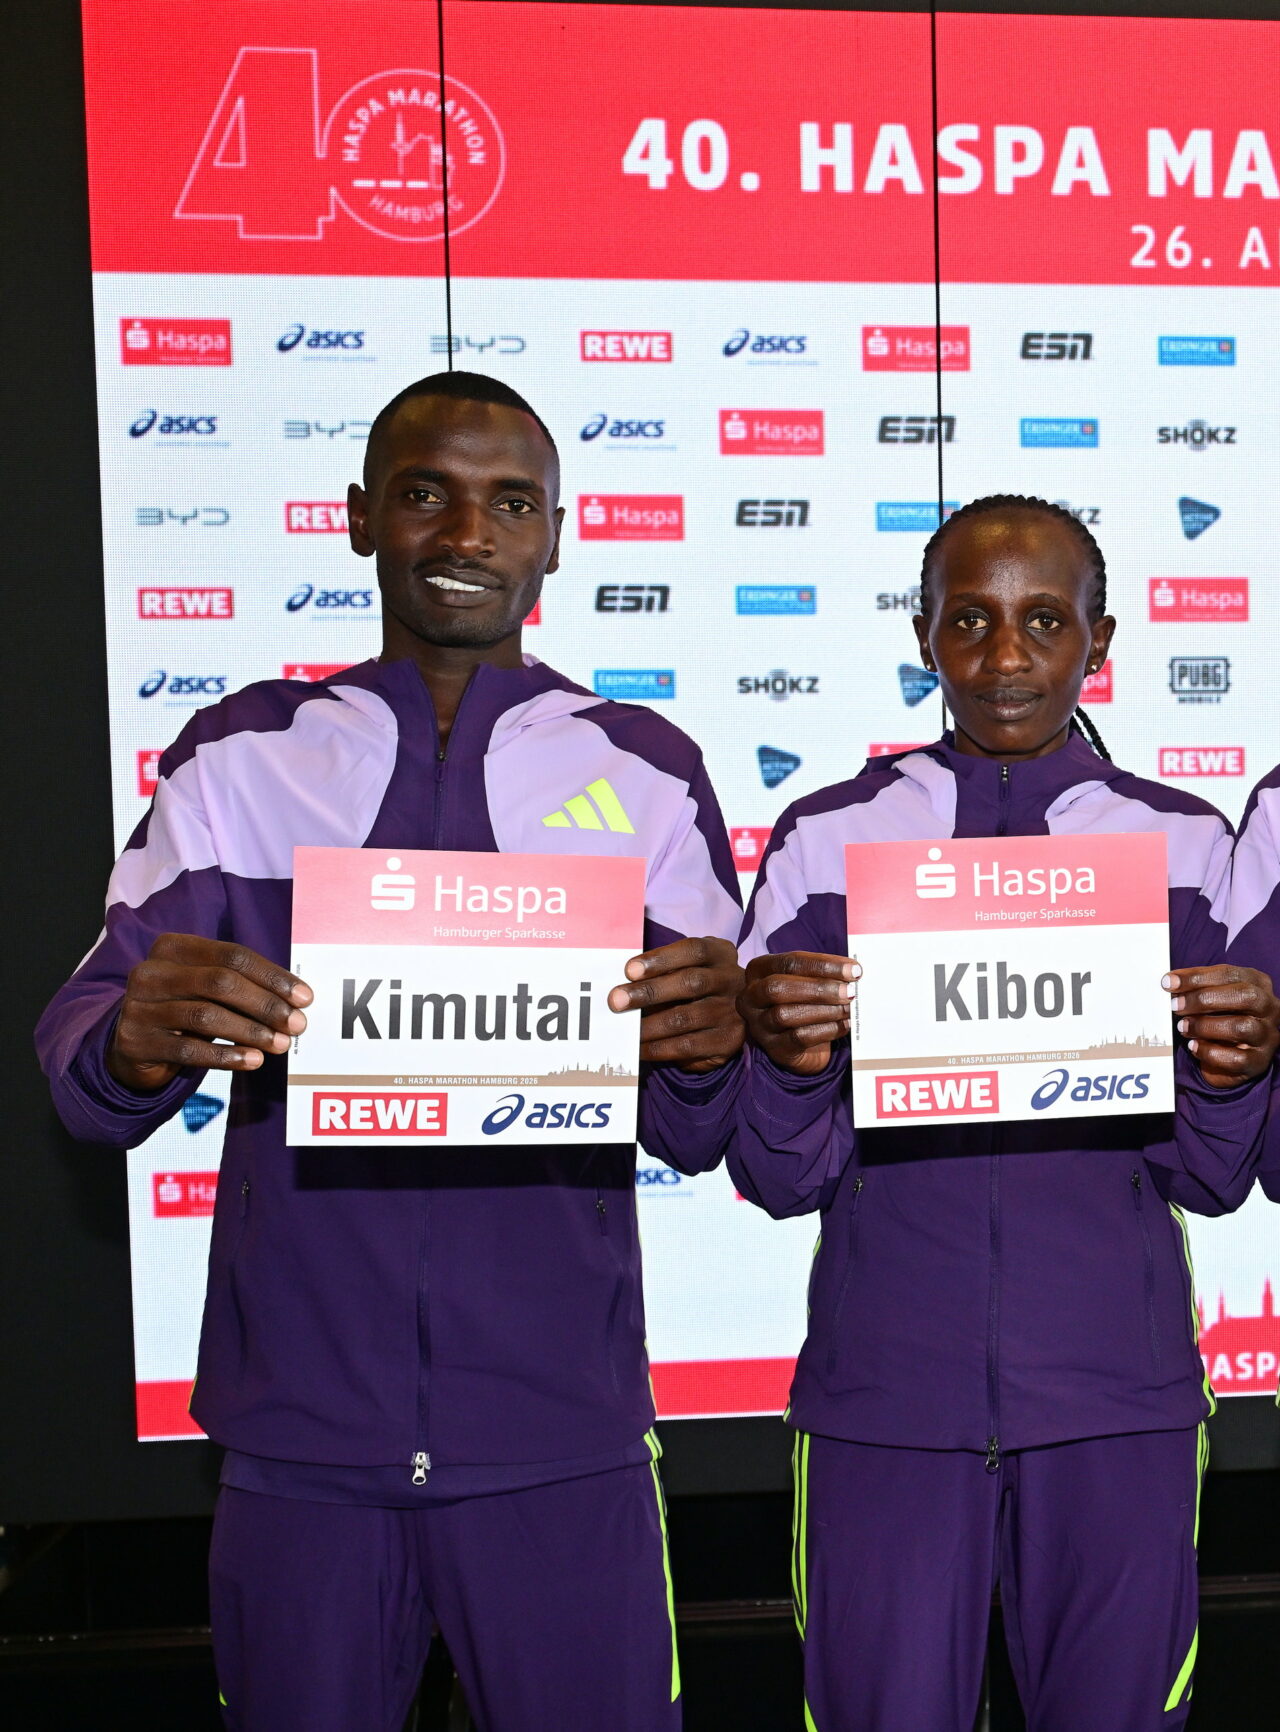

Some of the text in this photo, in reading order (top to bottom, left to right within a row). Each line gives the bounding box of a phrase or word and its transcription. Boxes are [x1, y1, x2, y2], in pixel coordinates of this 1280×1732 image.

[342, 98, 386, 162] HASPA
[622, 118, 760, 191] 40.
[800, 122, 1111, 195] HASPA
[1130, 225, 1213, 269] 26.
[157, 331, 227, 353] Haspa
[585, 334, 667, 358] REWE
[895, 337, 965, 358] Haspa
[1020, 332, 1093, 360] ESN
[753, 421, 820, 443] Haspa
[877, 416, 957, 443] ESN
[1157, 426, 1237, 444] SHOKZ
[136, 507, 230, 525] BYD
[291, 506, 349, 529] REW
[612, 506, 678, 528] Haspa
[736, 500, 810, 527] ESN
[142, 592, 229, 616] REWE
[595, 585, 670, 612] ESN
[1181, 590, 1244, 611] Haspa
[737, 677, 820, 694] SHOKZ
[1178, 663, 1222, 687] PUBG
[1161, 750, 1240, 773] REWE
[973, 862, 1096, 903] Haspa
[433, 876, 567, 922] Haspa
[975, 908, 1096, 922] Hamburger Sparkasse
[433, 926, 566, 939] Hamburger Sparkasse
[934, 961, 1091, 1022] Kibor
[341, 978, 592, 1041] Kimutai
[947, 1052, 1080, 1065] 40. HASPA MARATHON HAMBURG 2026
[394, 1077, 538, 1086] 40. HASPA MARATHON HAMBURG 2026
[881, 1077, 993, 1112] REWE
[319, 1099, 440, 1130] REWE
[1200, 1352, 1280, 1381] ASP
